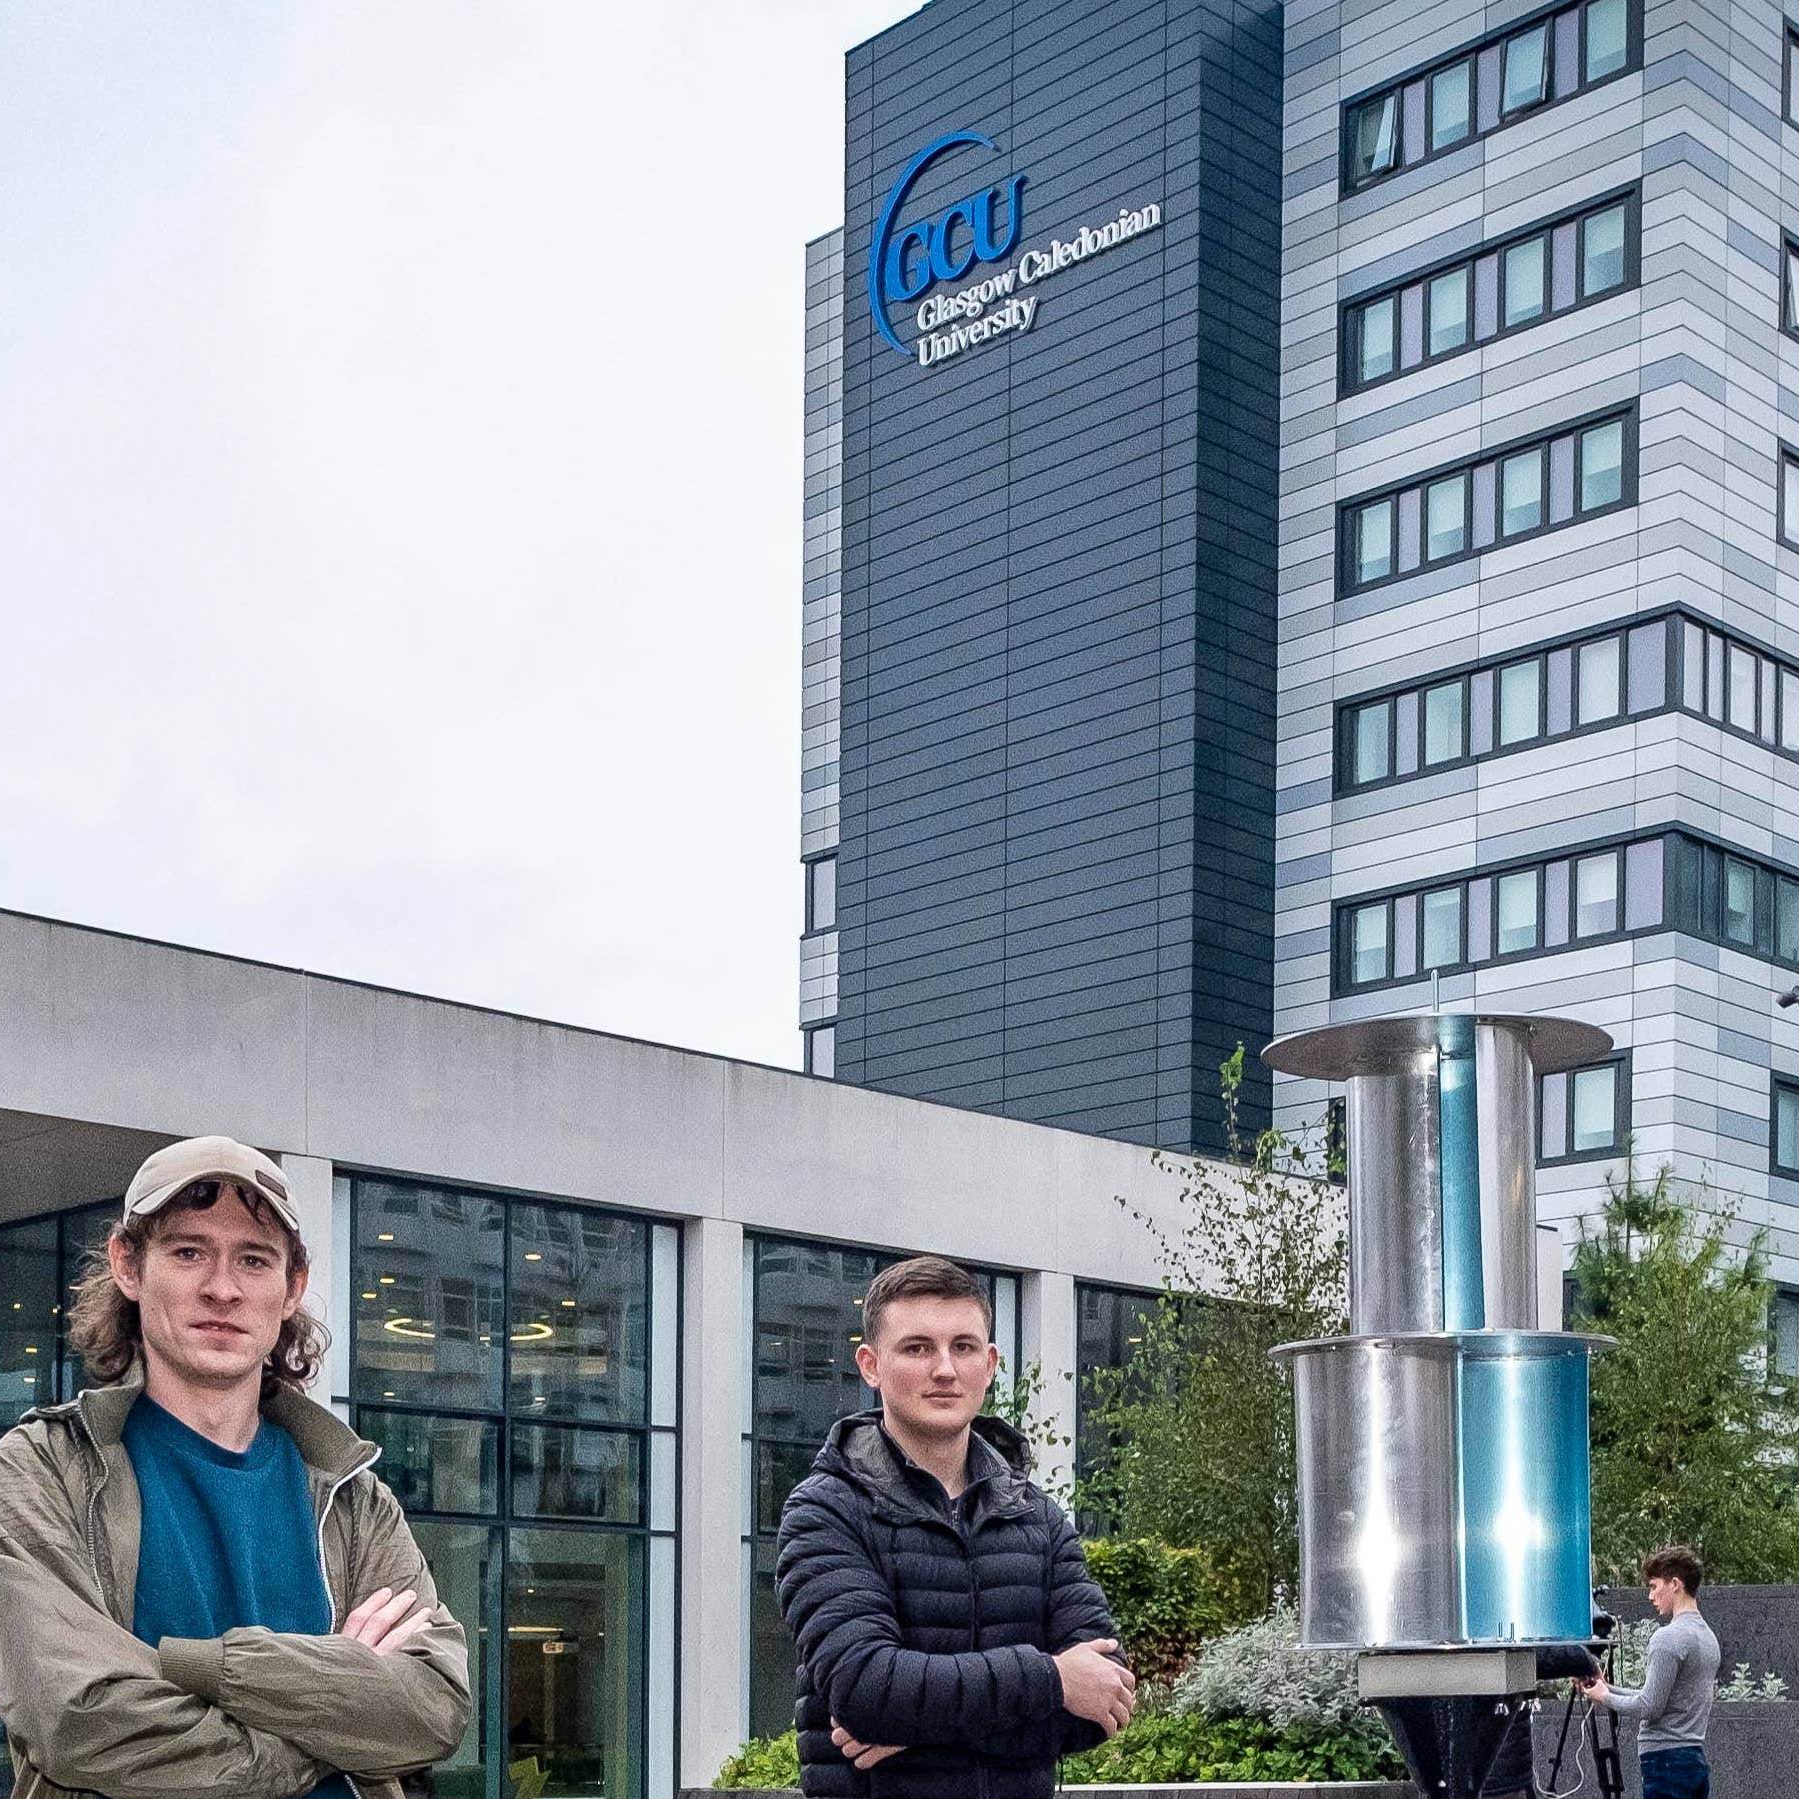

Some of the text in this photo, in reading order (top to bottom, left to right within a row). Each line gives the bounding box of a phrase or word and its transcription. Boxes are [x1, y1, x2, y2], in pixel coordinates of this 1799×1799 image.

[886, 175, 1025, 300] GCU
[917, 203, 1161, 331] Glasgow Caledonian
[917, 296, 1038, 366] University
